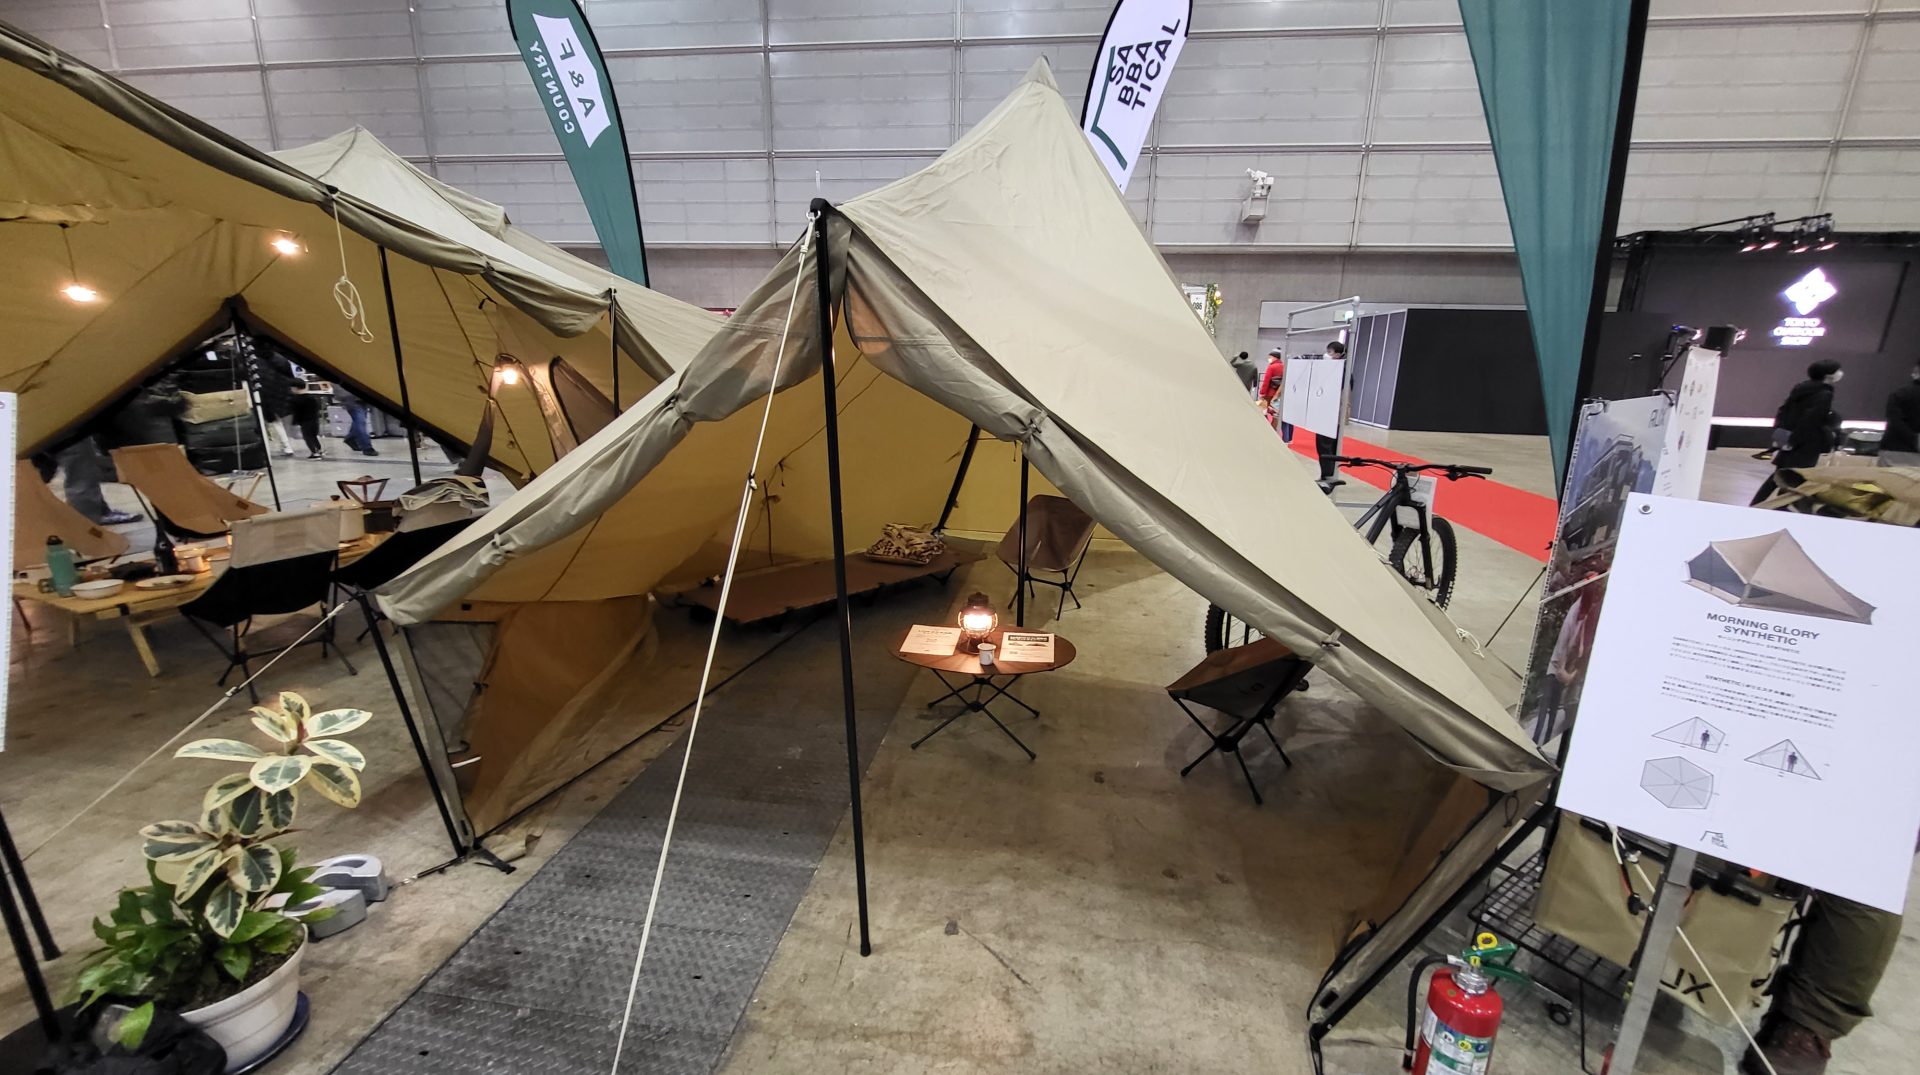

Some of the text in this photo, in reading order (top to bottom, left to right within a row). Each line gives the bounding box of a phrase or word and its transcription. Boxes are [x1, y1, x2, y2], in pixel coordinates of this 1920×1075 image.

[1109, 45, 1134, 86] SA
[1118, 41, 1153, 106] BBA
[1131, 18, 1181, 110] TICAL
[1706, 612, 1820, 640] MORNING GLORY
[1723, 625, 1798, 646] SYNTHETIC
